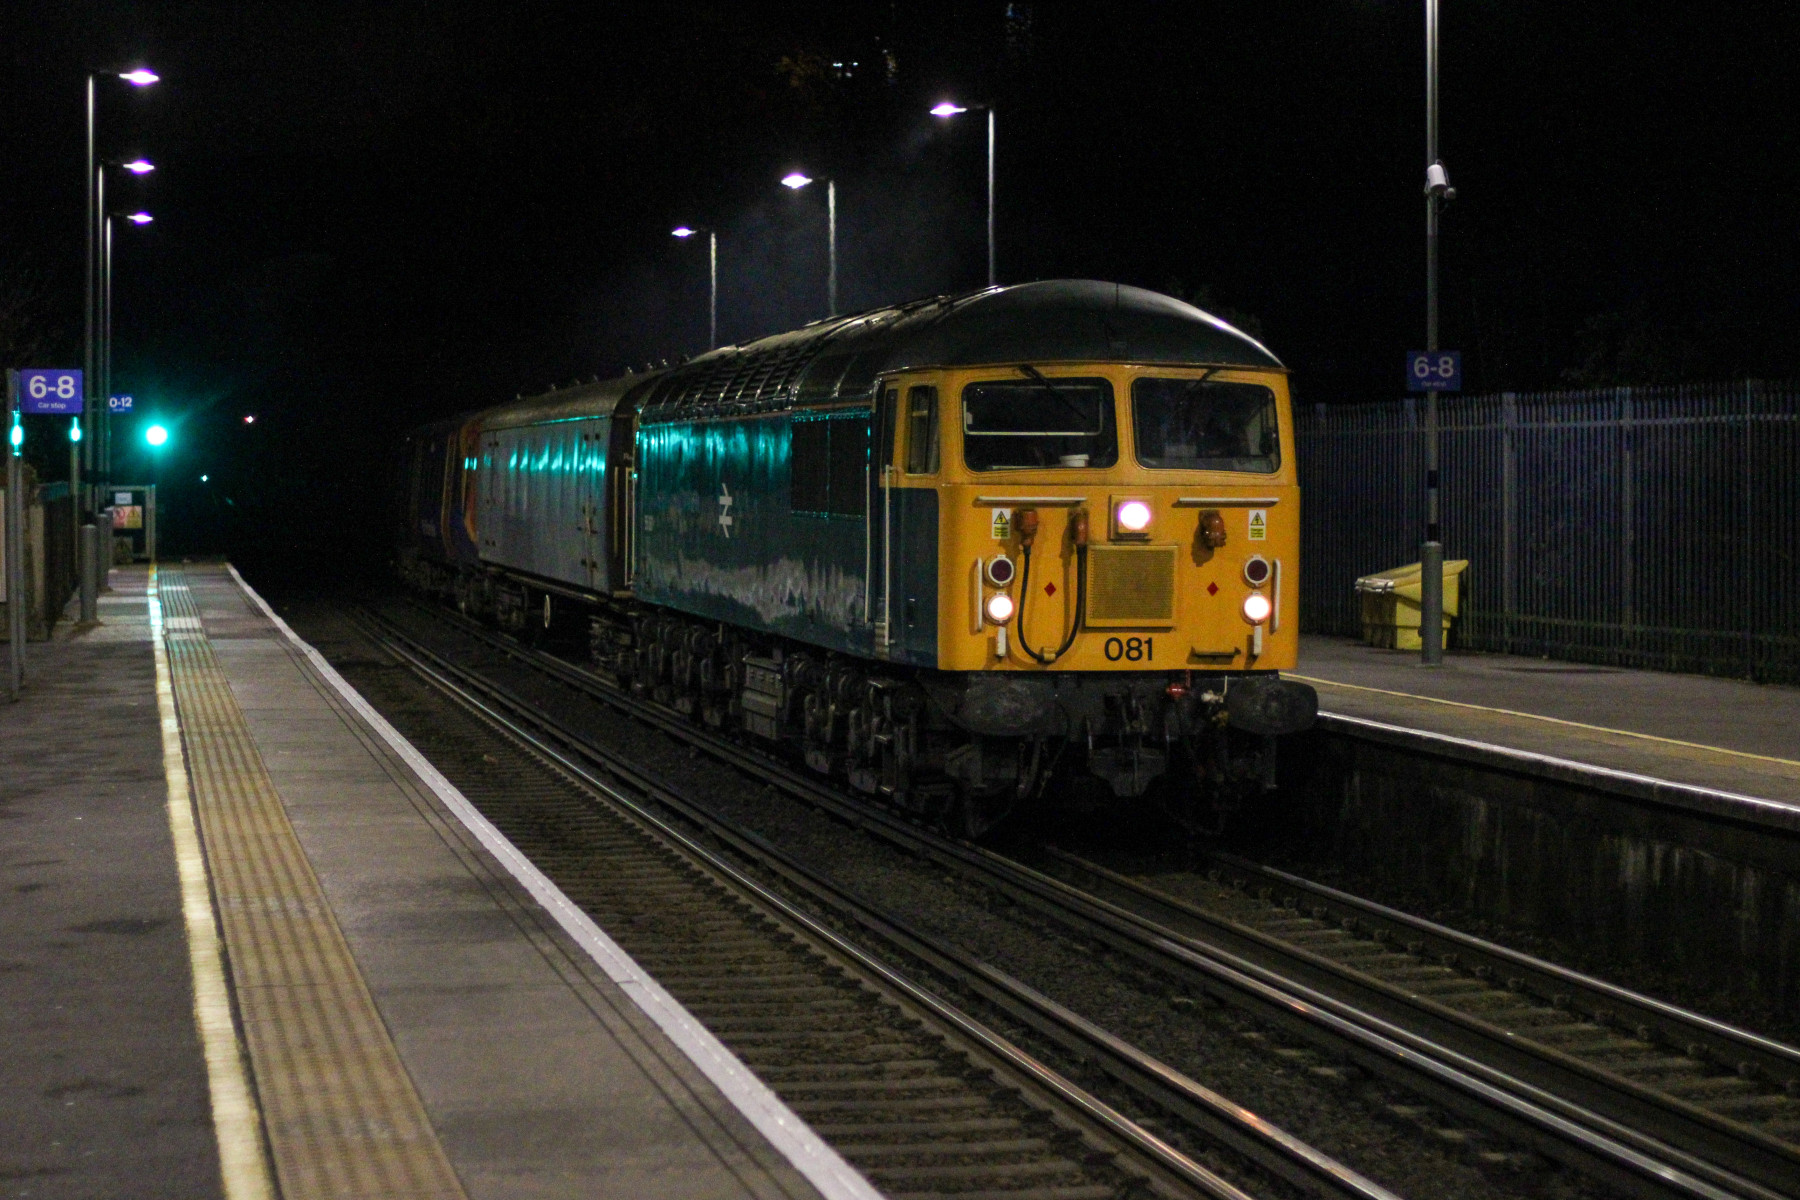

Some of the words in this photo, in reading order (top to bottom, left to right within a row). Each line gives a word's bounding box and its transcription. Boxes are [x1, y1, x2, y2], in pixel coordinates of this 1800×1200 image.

[1414, 356, 1454, 378] 6-8
[29, 375, 75, 399] 6-8
[51, 401, 66, 409] stop
[109, 397, 132, 408] 0-12
[1104, 637, 1152, 661] 081
